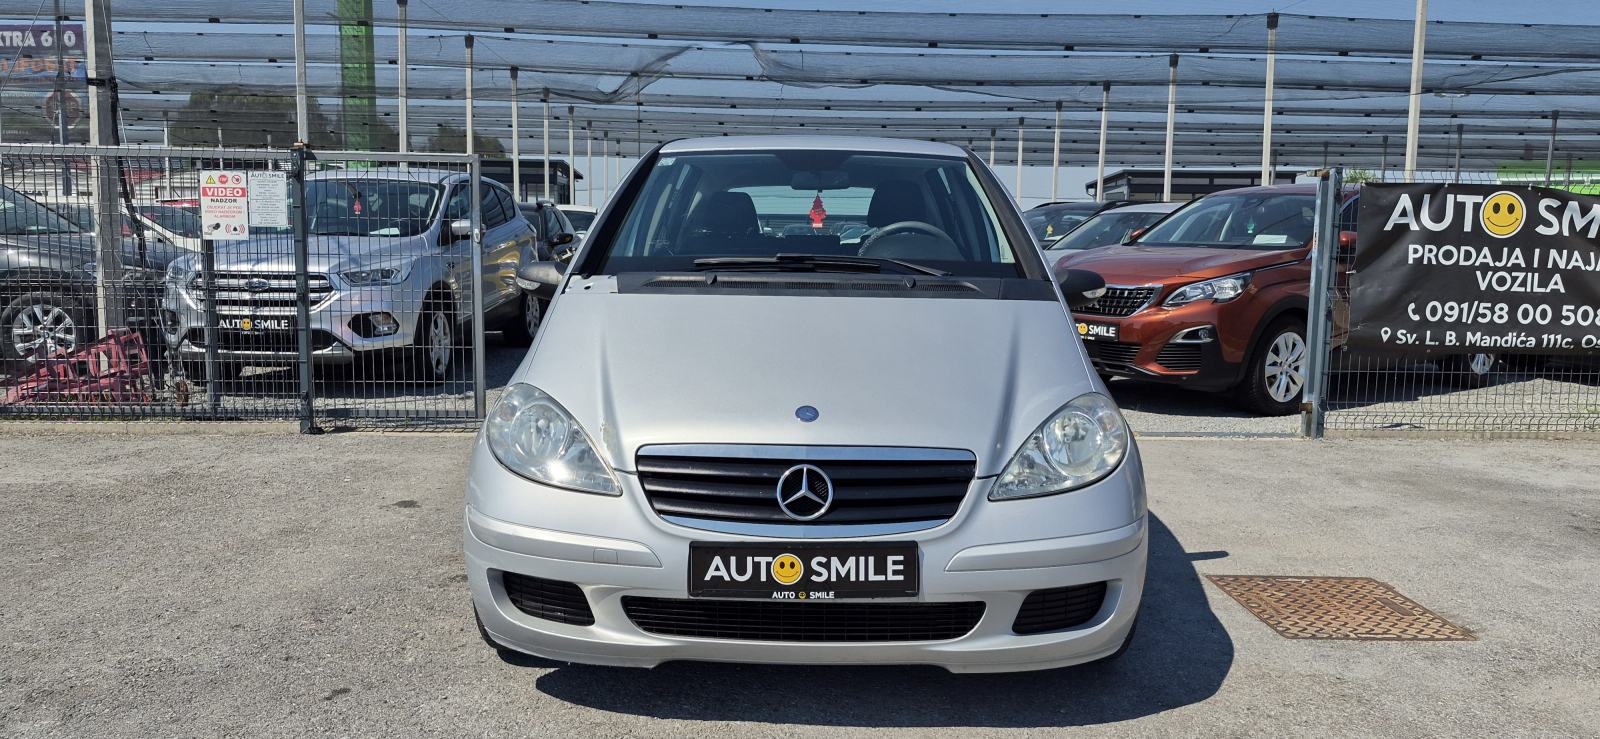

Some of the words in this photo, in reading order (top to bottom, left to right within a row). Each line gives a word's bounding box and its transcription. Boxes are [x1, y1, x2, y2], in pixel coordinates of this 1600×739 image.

[41, 30, 76, 47] 60
[206, 188, 242, 197] VIDEO
[1407, 244, 1526, 268] PRODAJA
[1533, 248, 1541, 268] I
[1547, 249, 1600, 272] NAJ
[1475, 270, 1566, 294] VOZILA
[1425, 300, 1509, 324] 091/58
[1516, 303, 1553, 325] 00
[254, 319, 289, 330] SMILE
[1089, 324, 1116, 337] SMILE
[1396, 329, 1420, 345] Sv.
[1425, 330, 1440, 346] L.
[1445, 331, 1460, 346] B.
[1465, 331, 1536, 348] Mandića
[810, 555, 904, 582] SMILE
[772, 591, 795, 599] AUTO
[809, 591, 835, 599] SMILE
